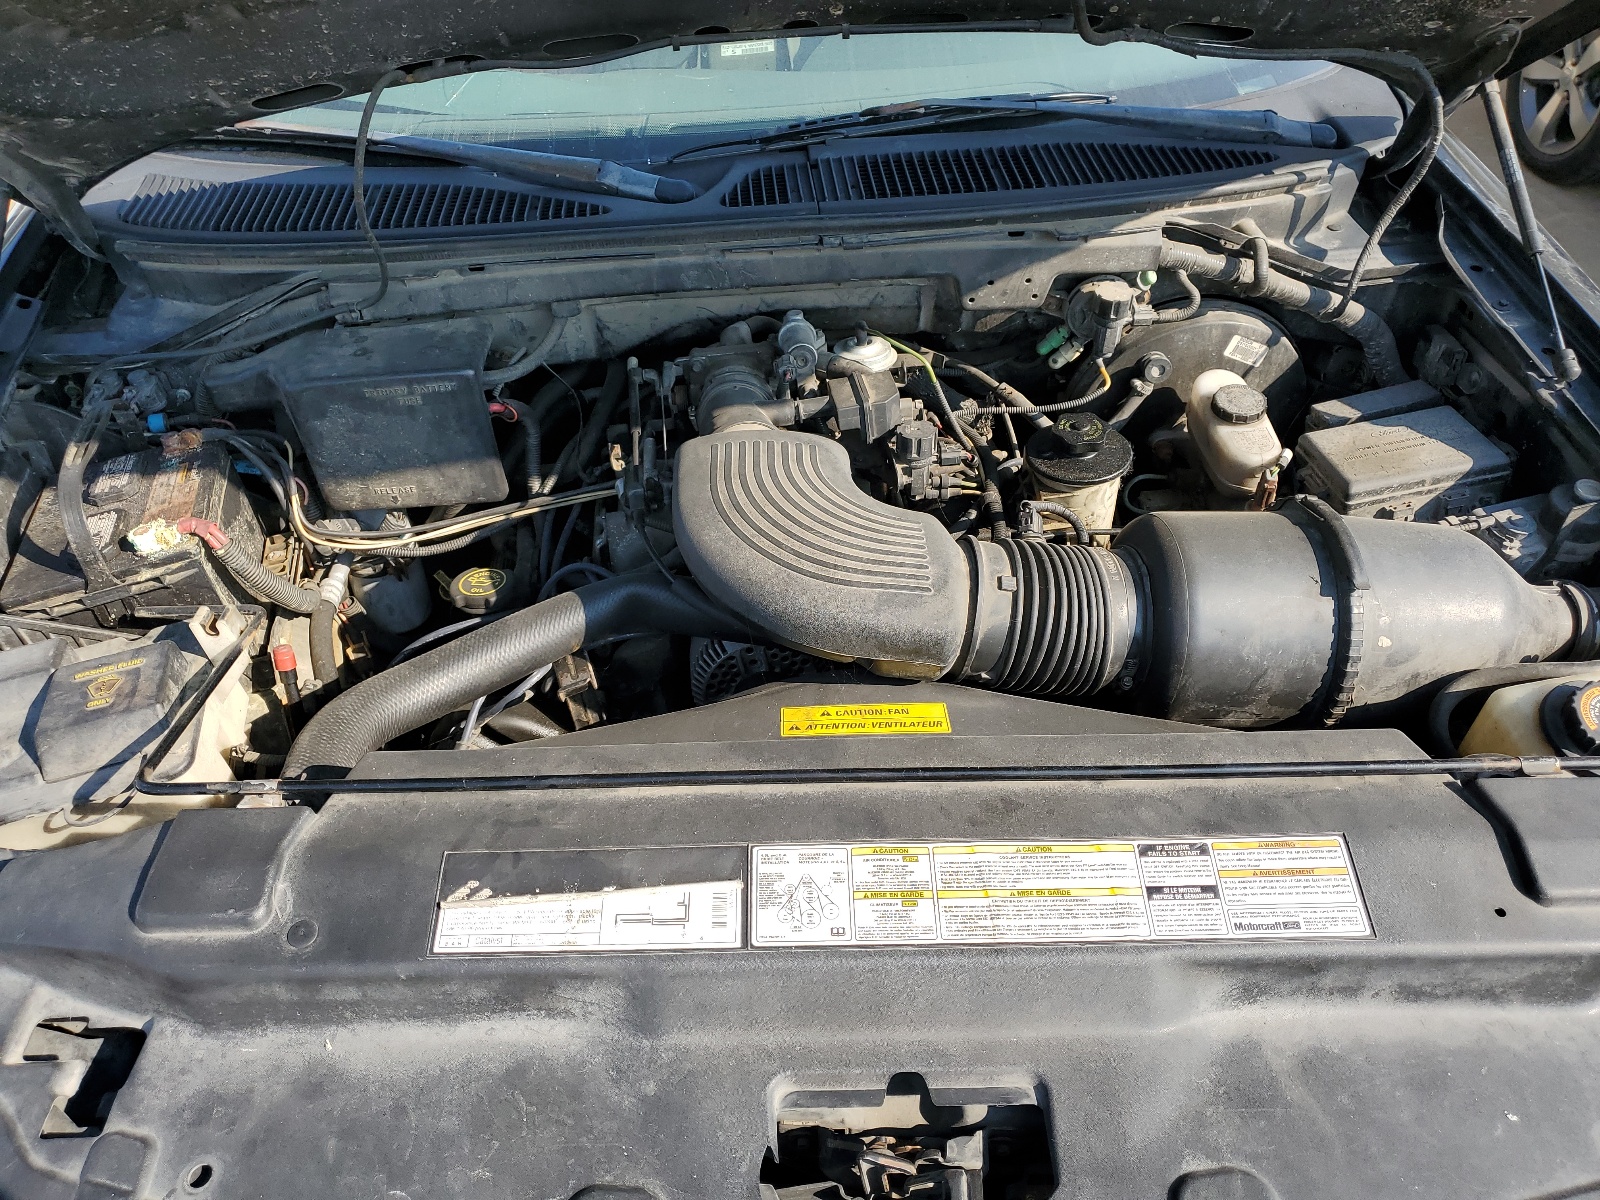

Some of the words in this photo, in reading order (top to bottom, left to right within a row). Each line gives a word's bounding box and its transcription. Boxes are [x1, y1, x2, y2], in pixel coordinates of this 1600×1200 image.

[363, 386, 407, 398] PRIMARY
[413, 382, 457, 394] BATTERY
[398, 396, 422, 406] FUSE
[374, 485, 417, 495] RELEASE
[74, 665, 115, 680] WASHER
[117, 657, 145, 670] FLUID
[86, 697, 111, 708] ONLY
[888, 707, 910, 716] FAN
[871, 720, 943, 729] VENTILATEUR
[1233, 922, 1283, 932] Motorcraft
